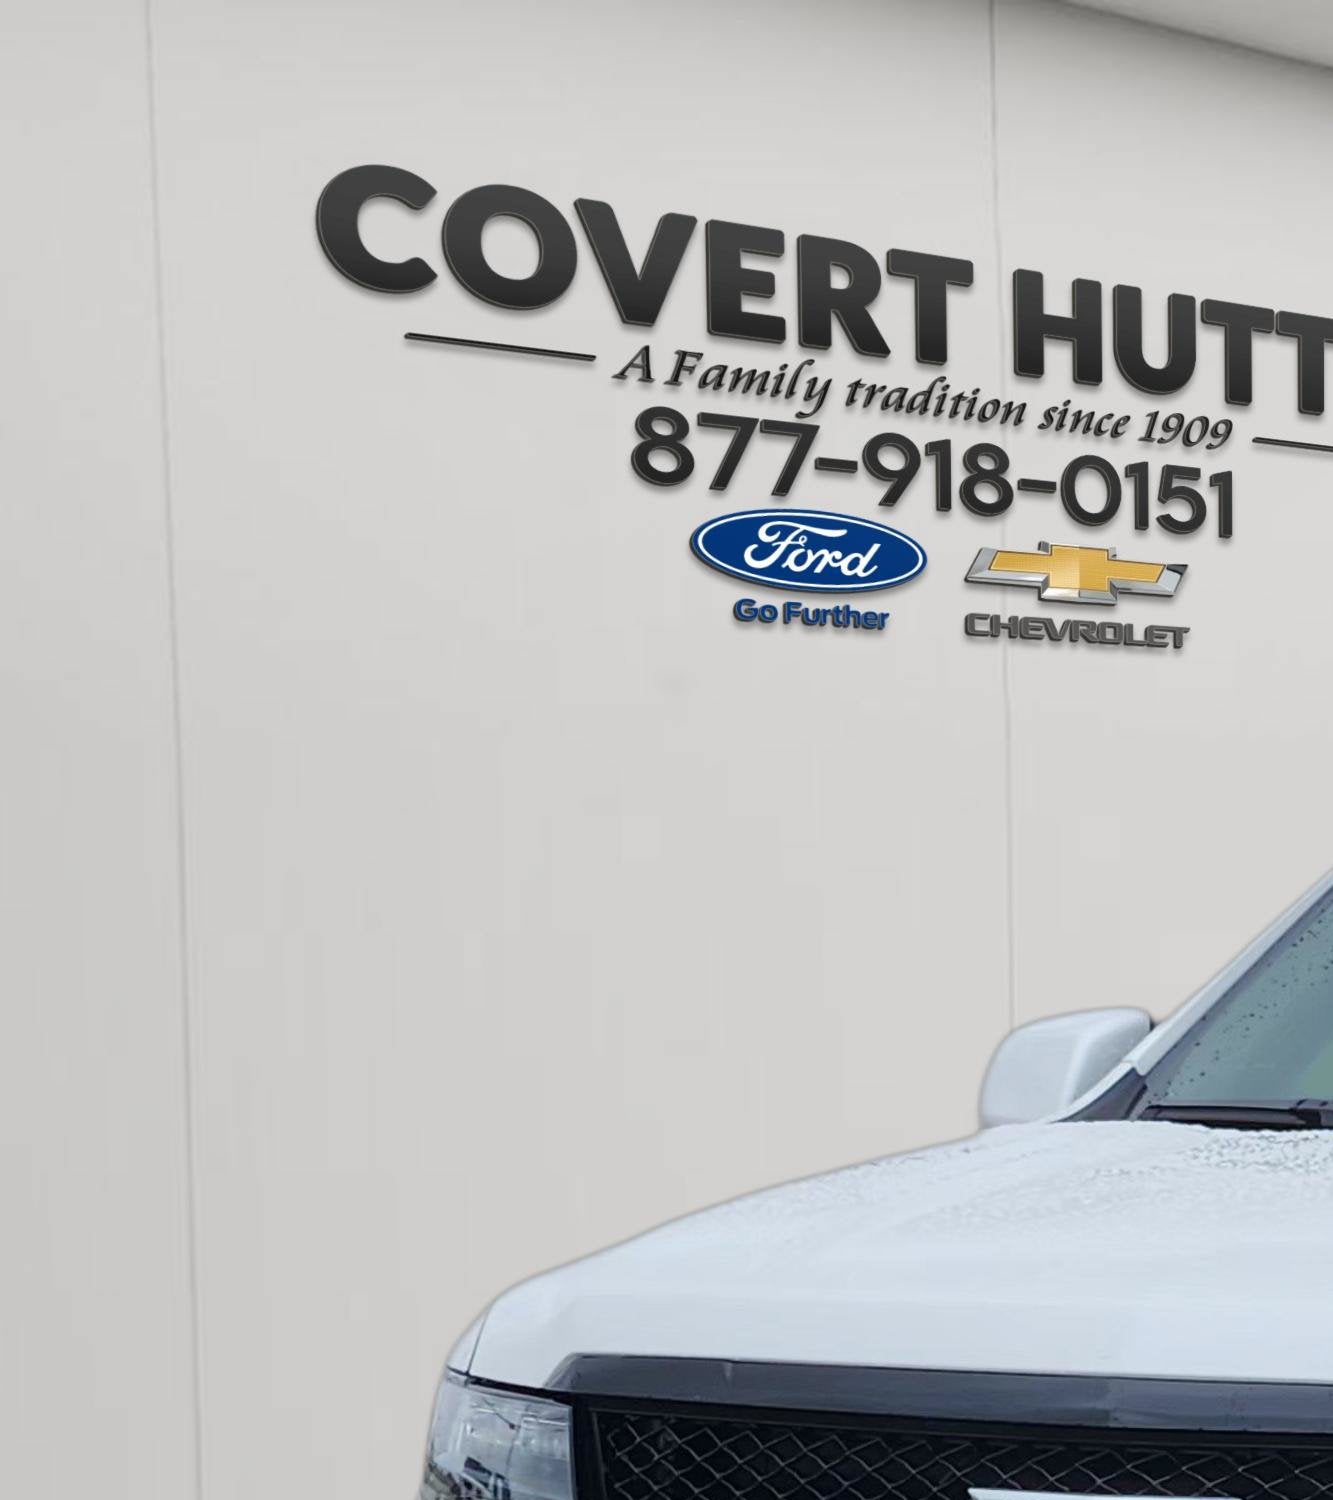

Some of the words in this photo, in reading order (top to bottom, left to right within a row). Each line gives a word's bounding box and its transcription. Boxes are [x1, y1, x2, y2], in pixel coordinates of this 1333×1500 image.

[315, 163, 974, 364] COVERT
[612, 345, 654, 382] A
[664, 348, 831, 419] Family
[845, 375, 1028, 428] tradition
[1037, 404, 1131, 440] since
[1138, 409, 1233, 450] 1909
[630, 405, 1234, 539] 877-918-0151
[743, 520, 881, 578] Ford
[733, 599, 782, 624] Go
[783, 601, 890, 631] Further
[964, 613, 1191, 650] CHEVROLET
